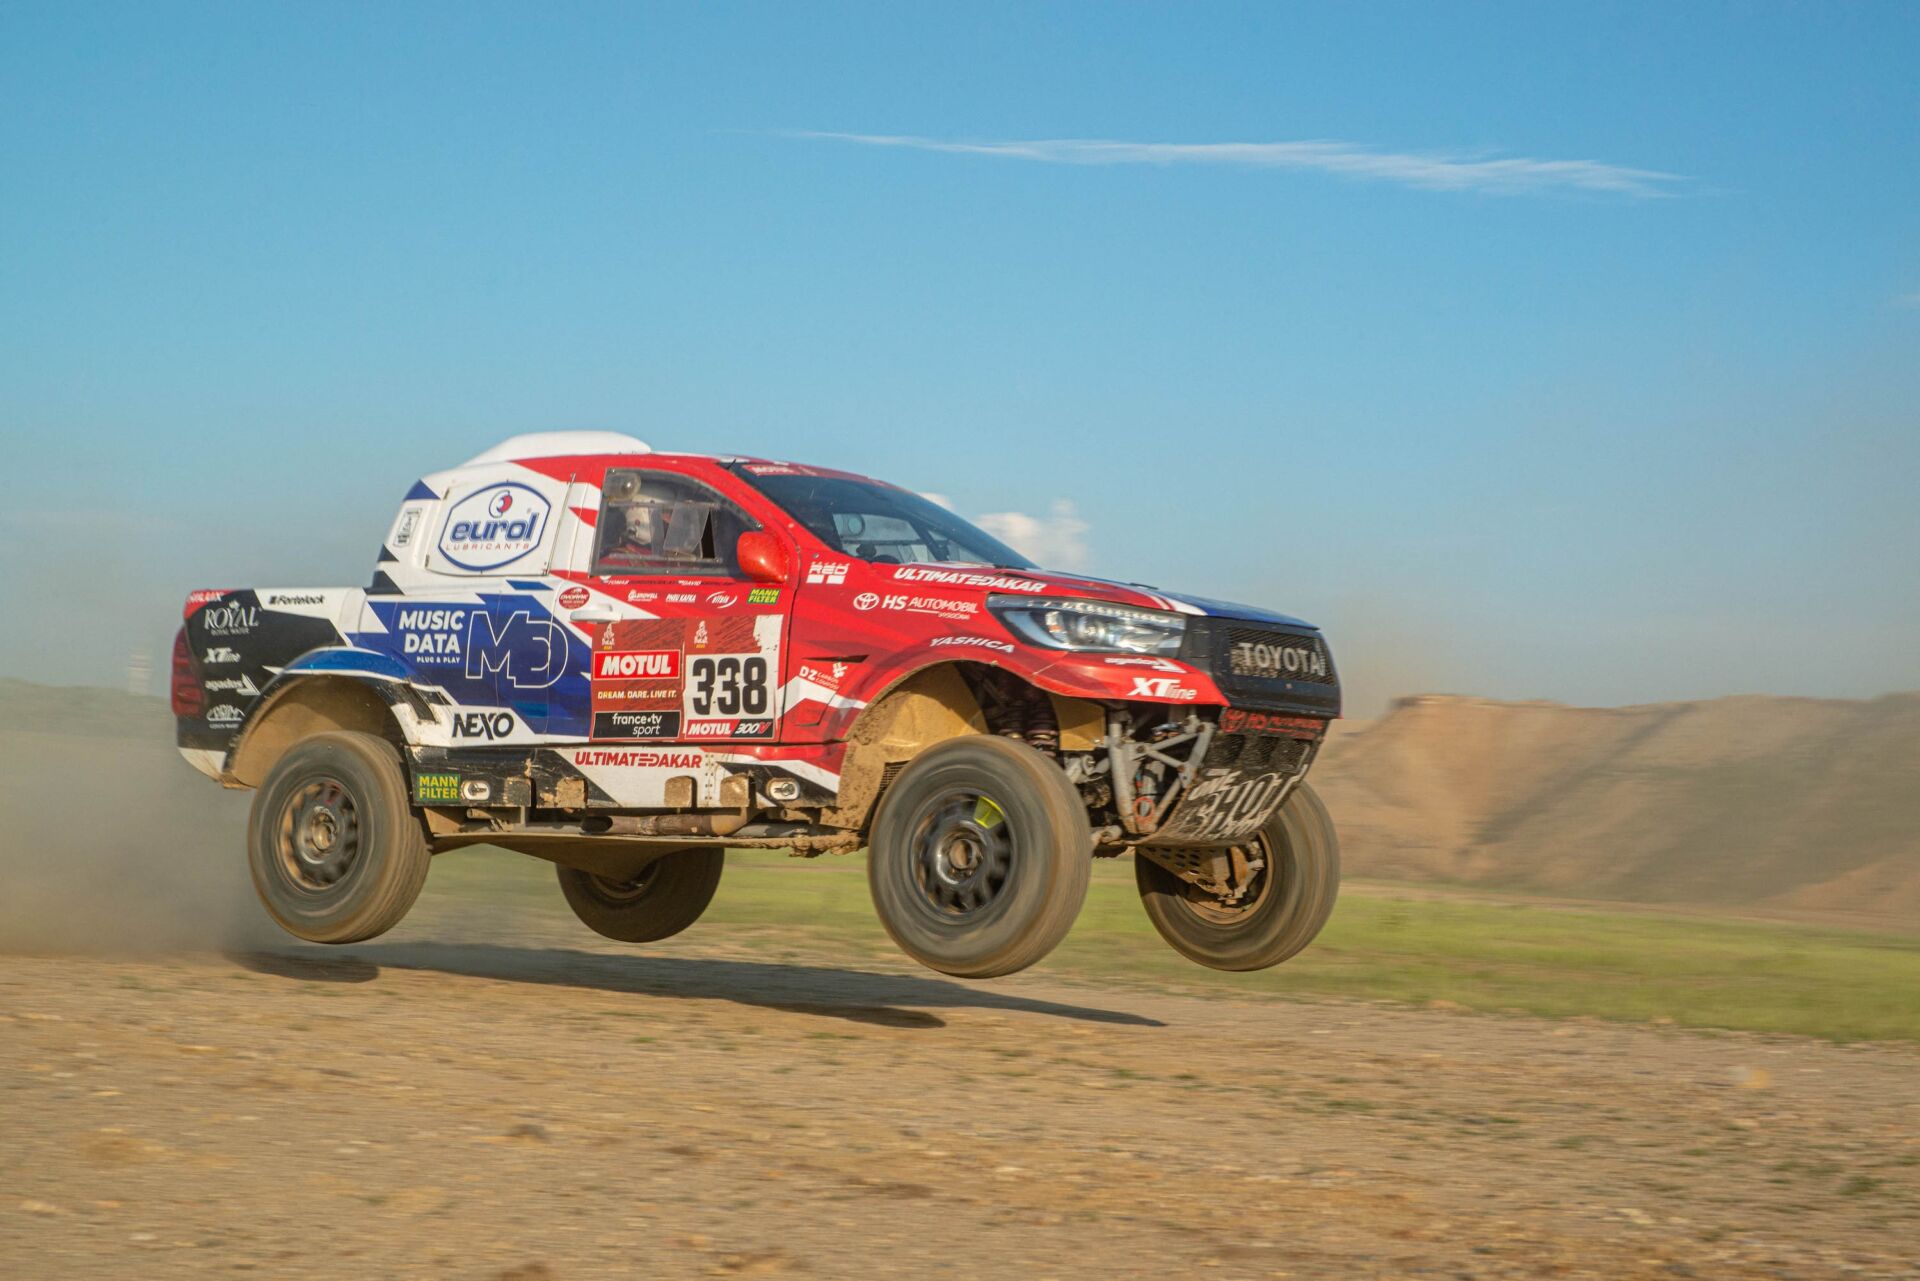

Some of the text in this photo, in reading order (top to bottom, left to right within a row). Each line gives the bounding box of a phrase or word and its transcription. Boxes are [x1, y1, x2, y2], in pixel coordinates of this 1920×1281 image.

[450, 512, 540, 542] eurol
[445, 543, 530, 551] LUBRICANTS
[747, 595, 777, 604] FILTER
[751, 588, 780, 596] MANN
[881, 594, 980, 614] HS AUTOMOBIL
[203, 606, 260, 630] ROYAL
[398, 610, 466, 631] MUSIC
[404, 633, 461, 654] DATA
[928, 636, 1016, 654] YASHICA
[443, 656, 461, 664] PLAY
[600, 654, 672, 676] MOTUL
[1238, 642, 1321, 676] TOYOTA
[799, 665, 818, 681] DZ
[597, 690, 627, 700] DREAM.
[627, 690, 650, 699] DARE.
[650, 690, 668, 699] LIVE
[692, 657, 768, 716] 338
[452, 711, 515, 740] NEXO
[632, 725, 661, 736] sport
[687, 721, 772, 736] MOTUL 300V
[419, 776, 459, 788] MANN
[419, 787, 459, 800] FILTER
